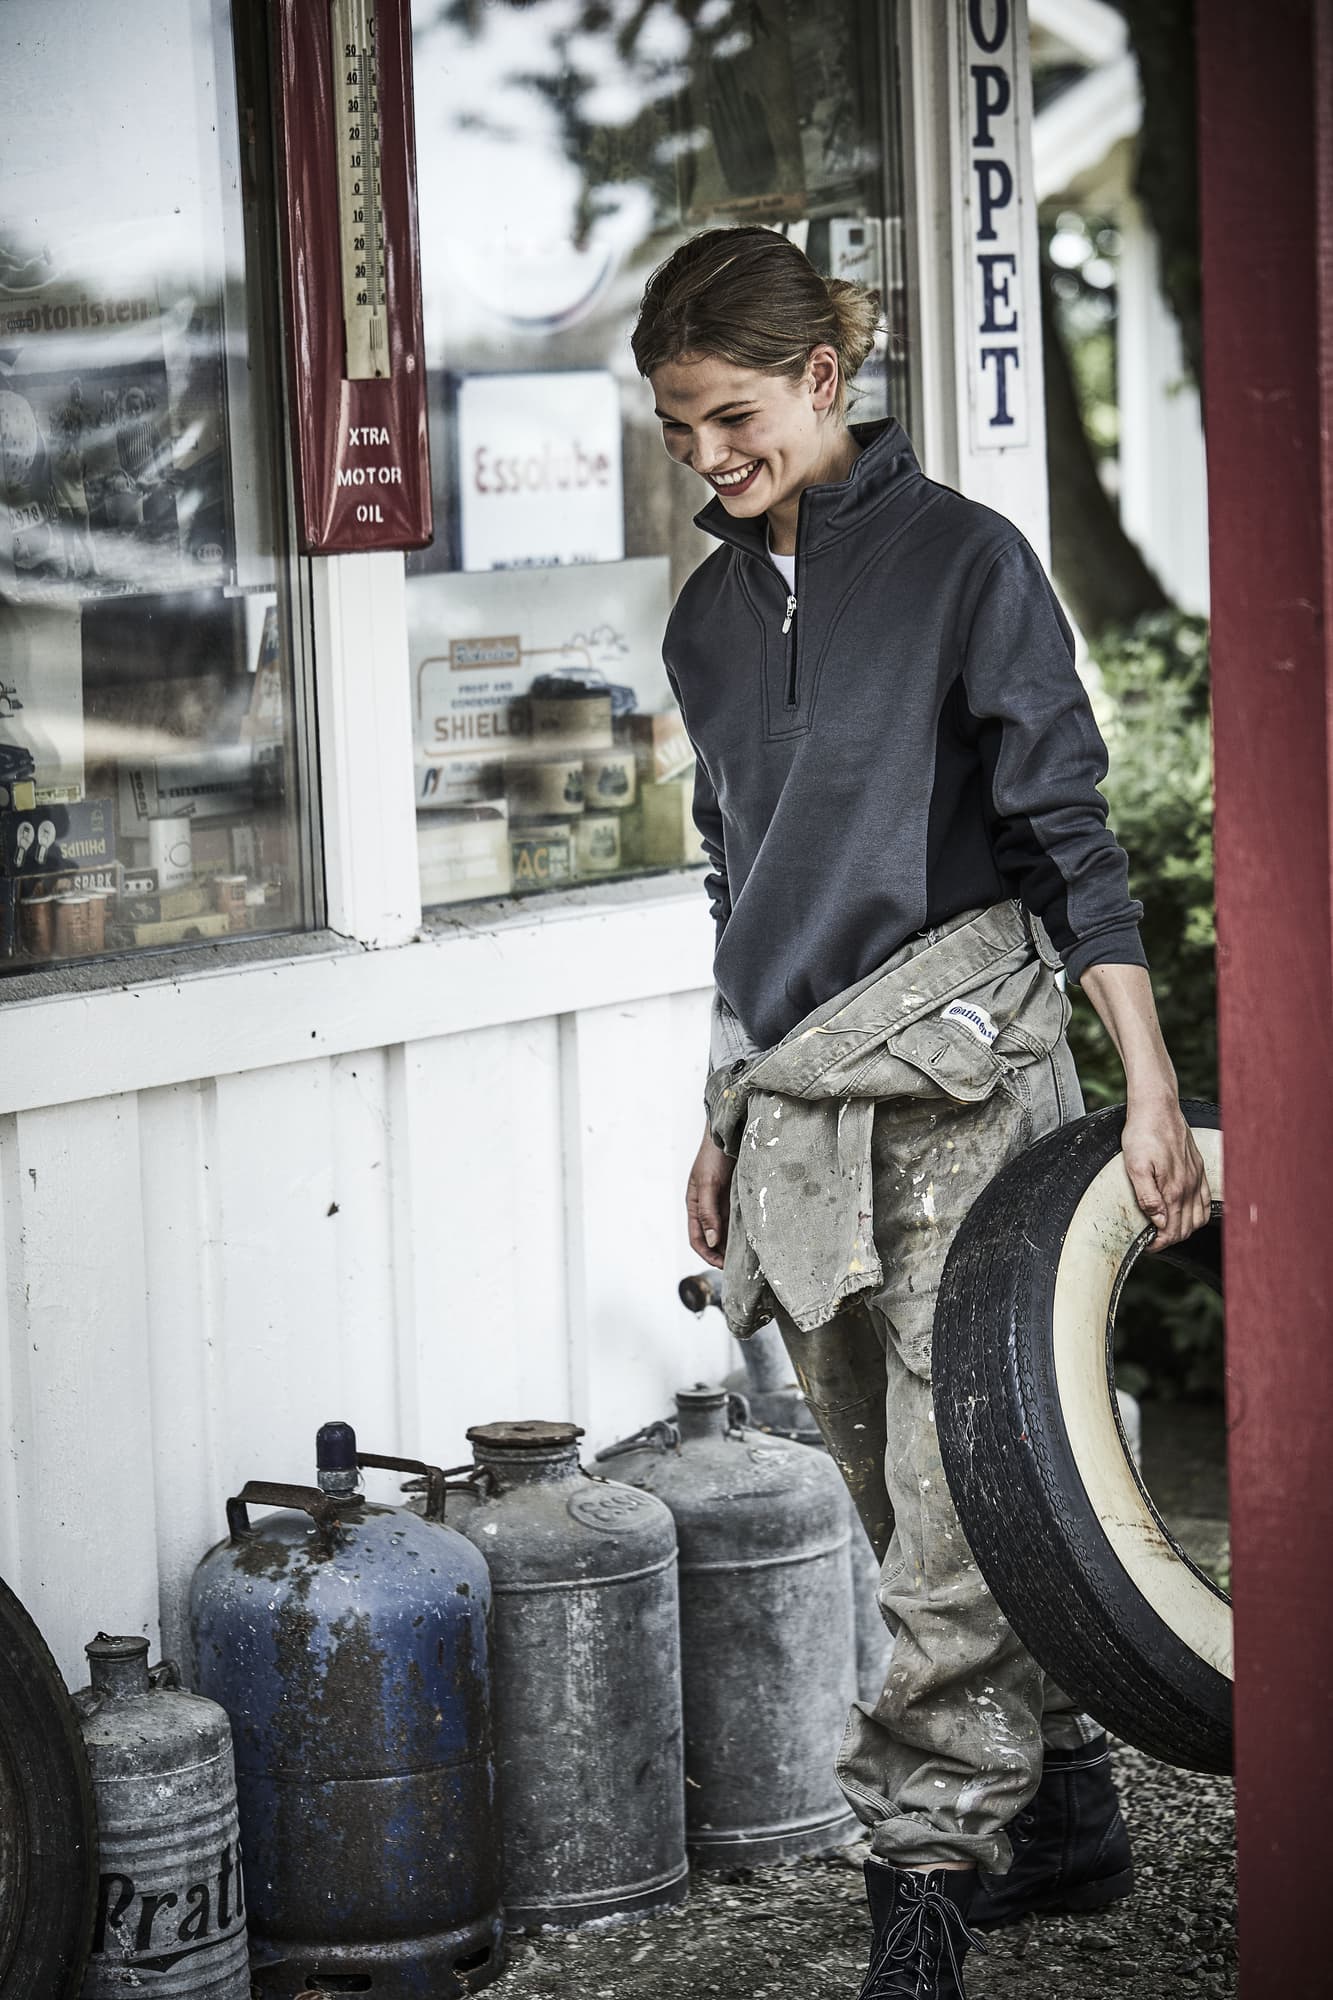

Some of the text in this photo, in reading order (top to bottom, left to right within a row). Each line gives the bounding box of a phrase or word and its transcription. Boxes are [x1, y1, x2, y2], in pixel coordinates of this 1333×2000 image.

[346, 44, 356, 56] 50
[347, 72, 357, 83] 40
[348, 100, 358, 111] 30
[349, 127, 360, 138] 20
[351, 155, 361, 166] 10
[354, 183, 360, 194] 0
[353, 210, 363, 222] 10
[354, 238, 365, 249] 20
[355, 266, 366, 277] 30
[356, 293, 367, 304] 40
[349, 427, 390, 446] XTRA
[337, 466, 402, 487] MOTOR
[356, 504, 384, 523] OIL
[435, 712, 523, 741] SHIELD
[60, 839, 106, 859] PHILIPS
[517, 847, 548, 879] AC
[74, 872, 113, 890] SPARK
